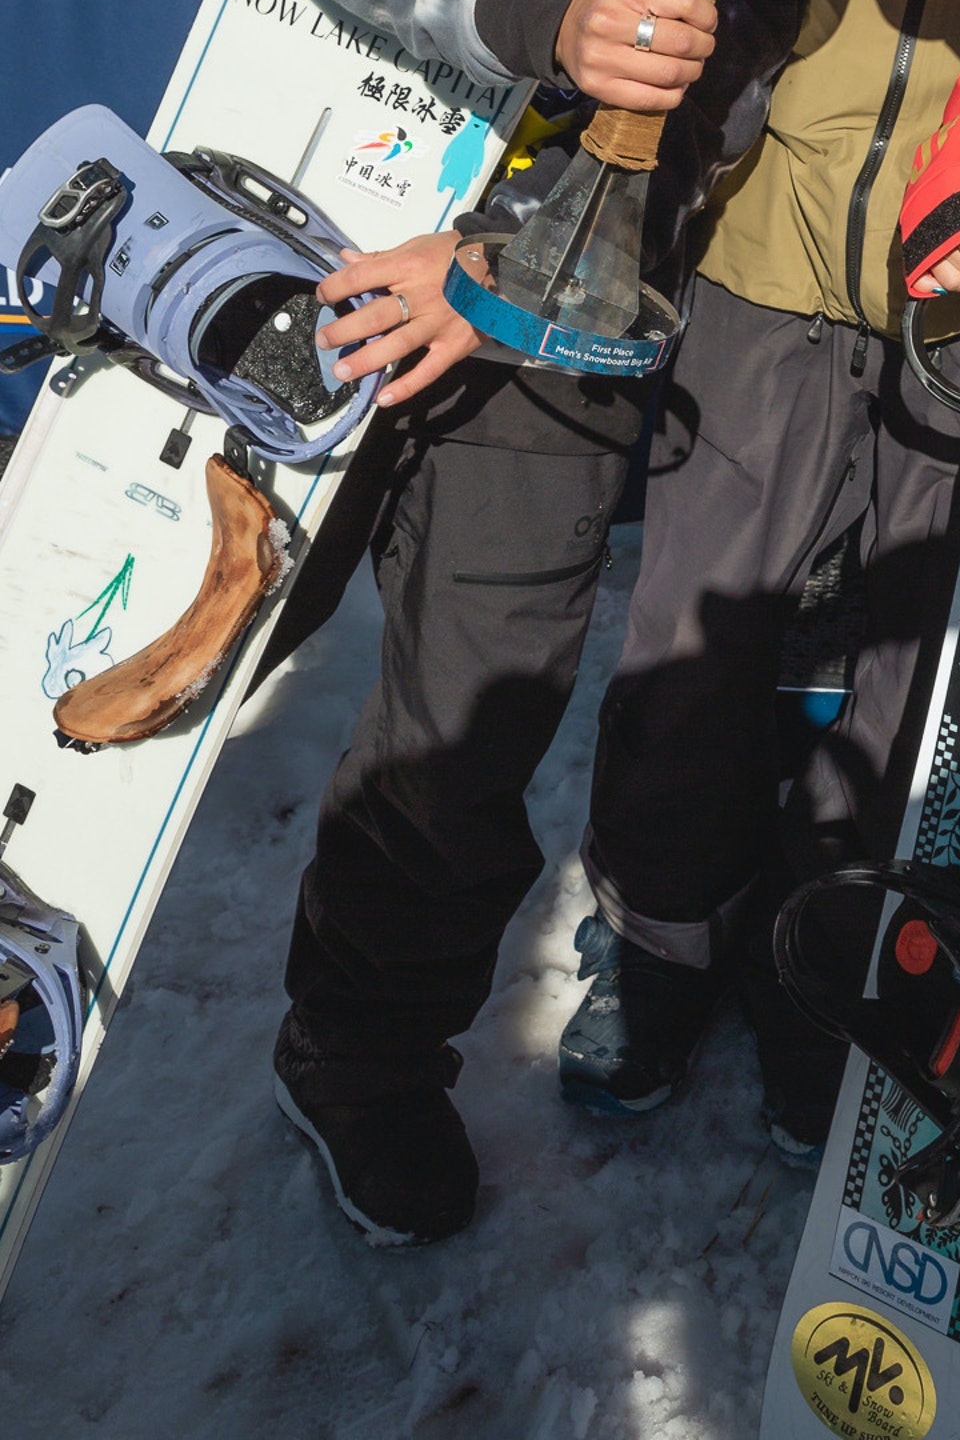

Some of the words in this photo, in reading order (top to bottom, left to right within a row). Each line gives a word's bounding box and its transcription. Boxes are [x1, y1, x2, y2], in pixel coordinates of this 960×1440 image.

[310, 12, 389, 61] LAKE
[555, 345, 582, 360] Men's
[583, 353, 630, 367] Snowboard
[630, 358, 642, 367] Big
[591, 344, 611, 356] First
[613, 347, 634, 357] Place
[838, 1266, 860, 1282] NIPPON
[861, 1277, 872, 1287] SKI
[872, 1283, 896, 1301] RESORT
[897, 1294, 941, 1324] DEVELOPMENT
[811, 1392, 839, 1426] TUNE
[840, 1421, 858, 1437] UP
[816, 1369, 835, 1387] Ski
[838, 1381, 849, 1394] &
[862, 1395, 894, 1419] Snow
[867, 1410, 903, 1437] Board
